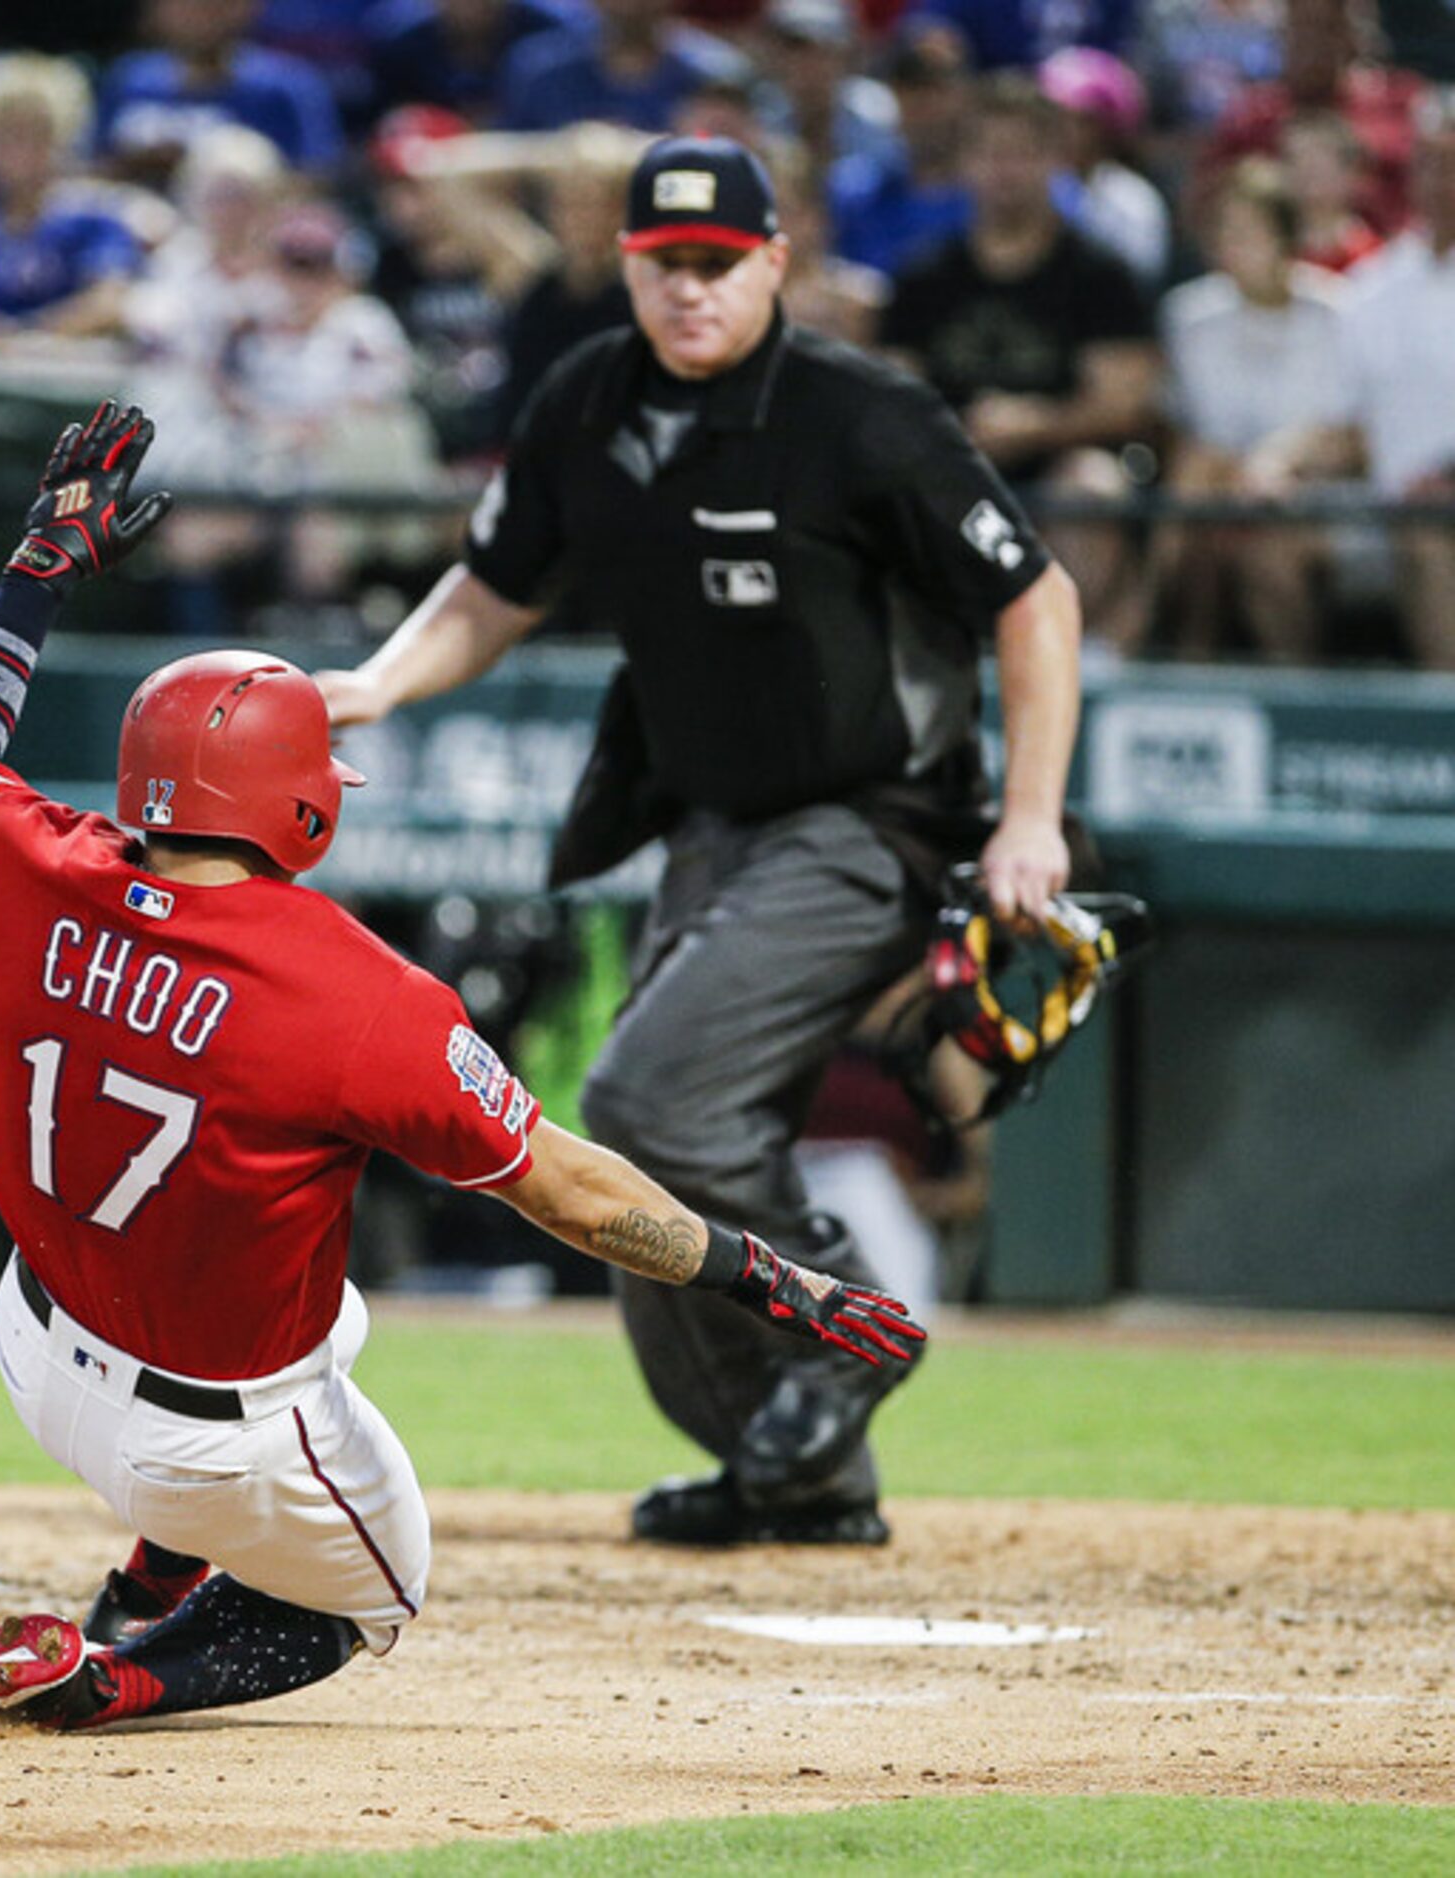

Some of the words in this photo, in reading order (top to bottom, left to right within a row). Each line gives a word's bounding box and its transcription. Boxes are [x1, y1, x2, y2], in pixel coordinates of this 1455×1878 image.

[147, 778, 177, 807] 17
[42, 916, 233, 1058] CHOO
[20, 1034, 201, 1234] 17
